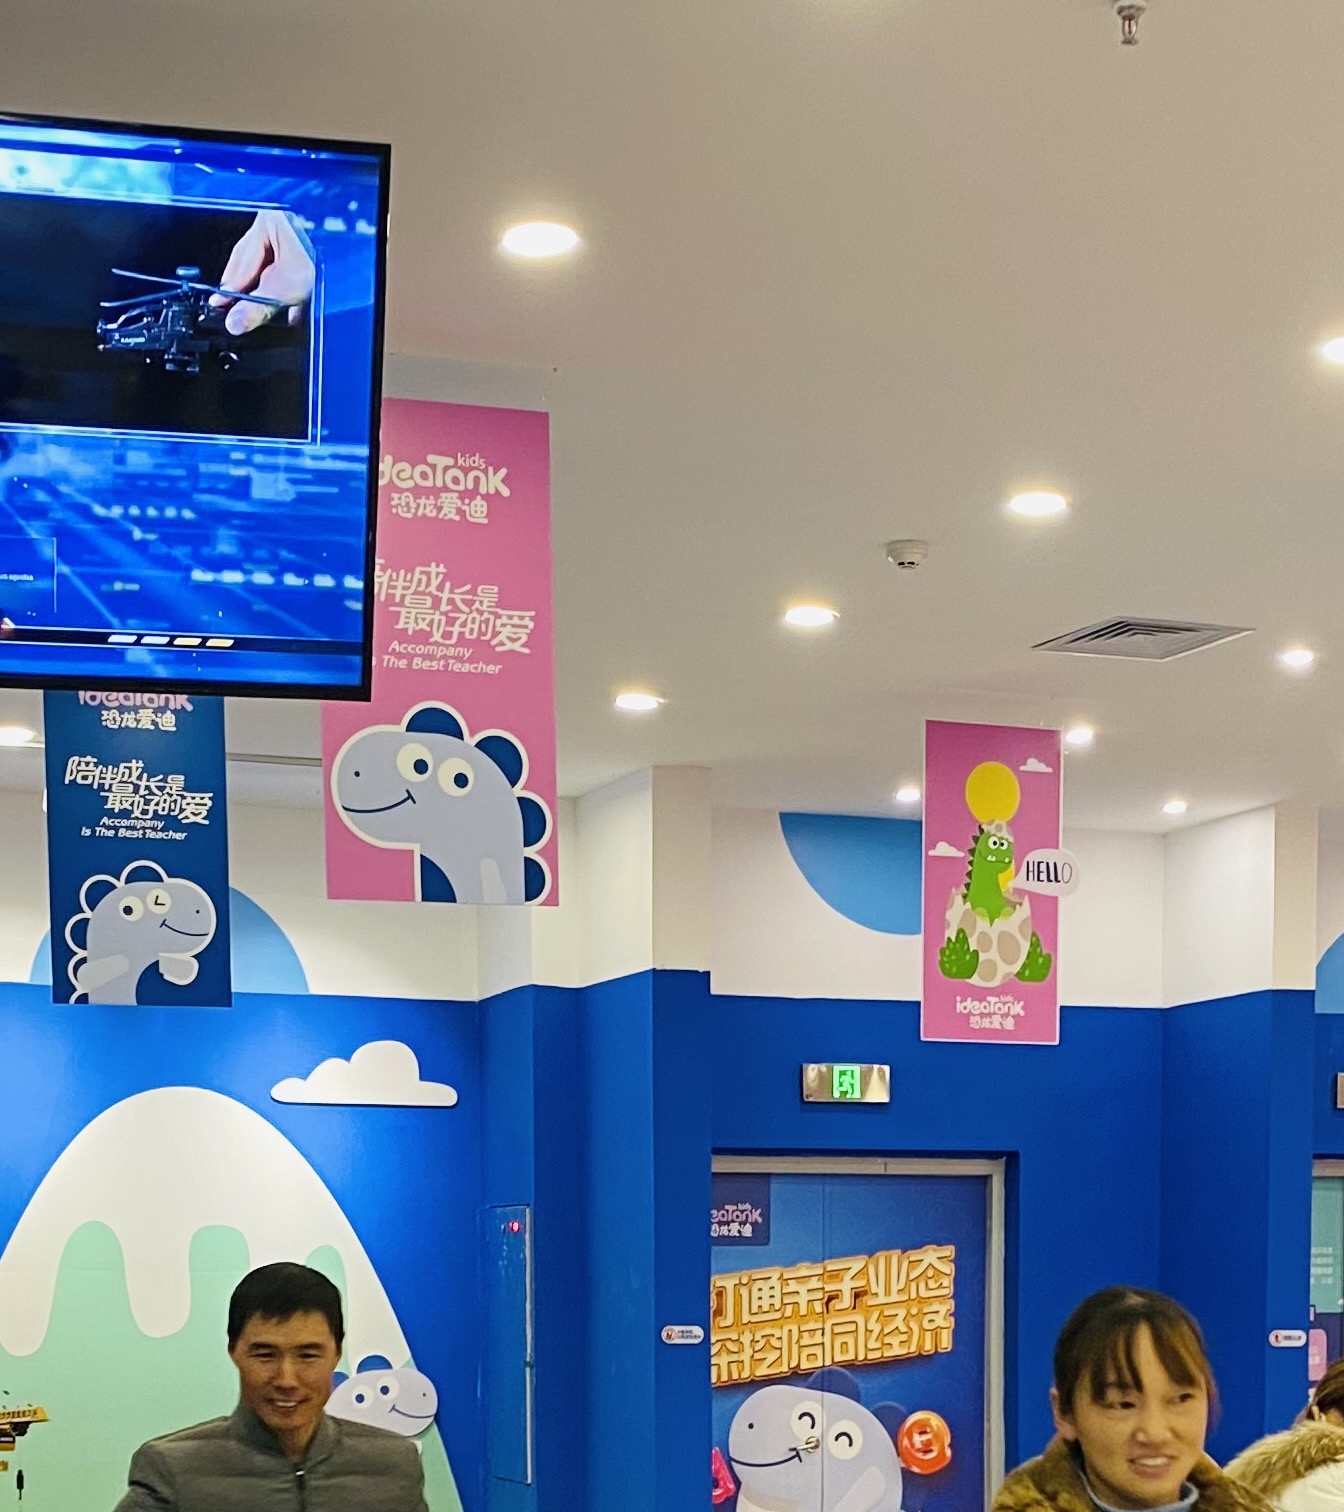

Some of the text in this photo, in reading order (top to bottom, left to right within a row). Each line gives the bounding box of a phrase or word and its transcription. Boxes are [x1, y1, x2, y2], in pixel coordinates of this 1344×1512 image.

[457, 452, 487, 470] kids
[390, 491, 488, 524] 恐龙爱迪
[388, 640, 473, 658] Accompany
[383, 655, 407, 669] The
[412, 657, 446, 671] Best
[447, 660, 503, 675] Teacher
[101, 709, 177, 732] 恐龙爱迪
[100, 816, 165, 830] Accompany
[81, 826, 188, 840] Is The Best Teacher
[1026, 860, 1073, 884] HELLO
